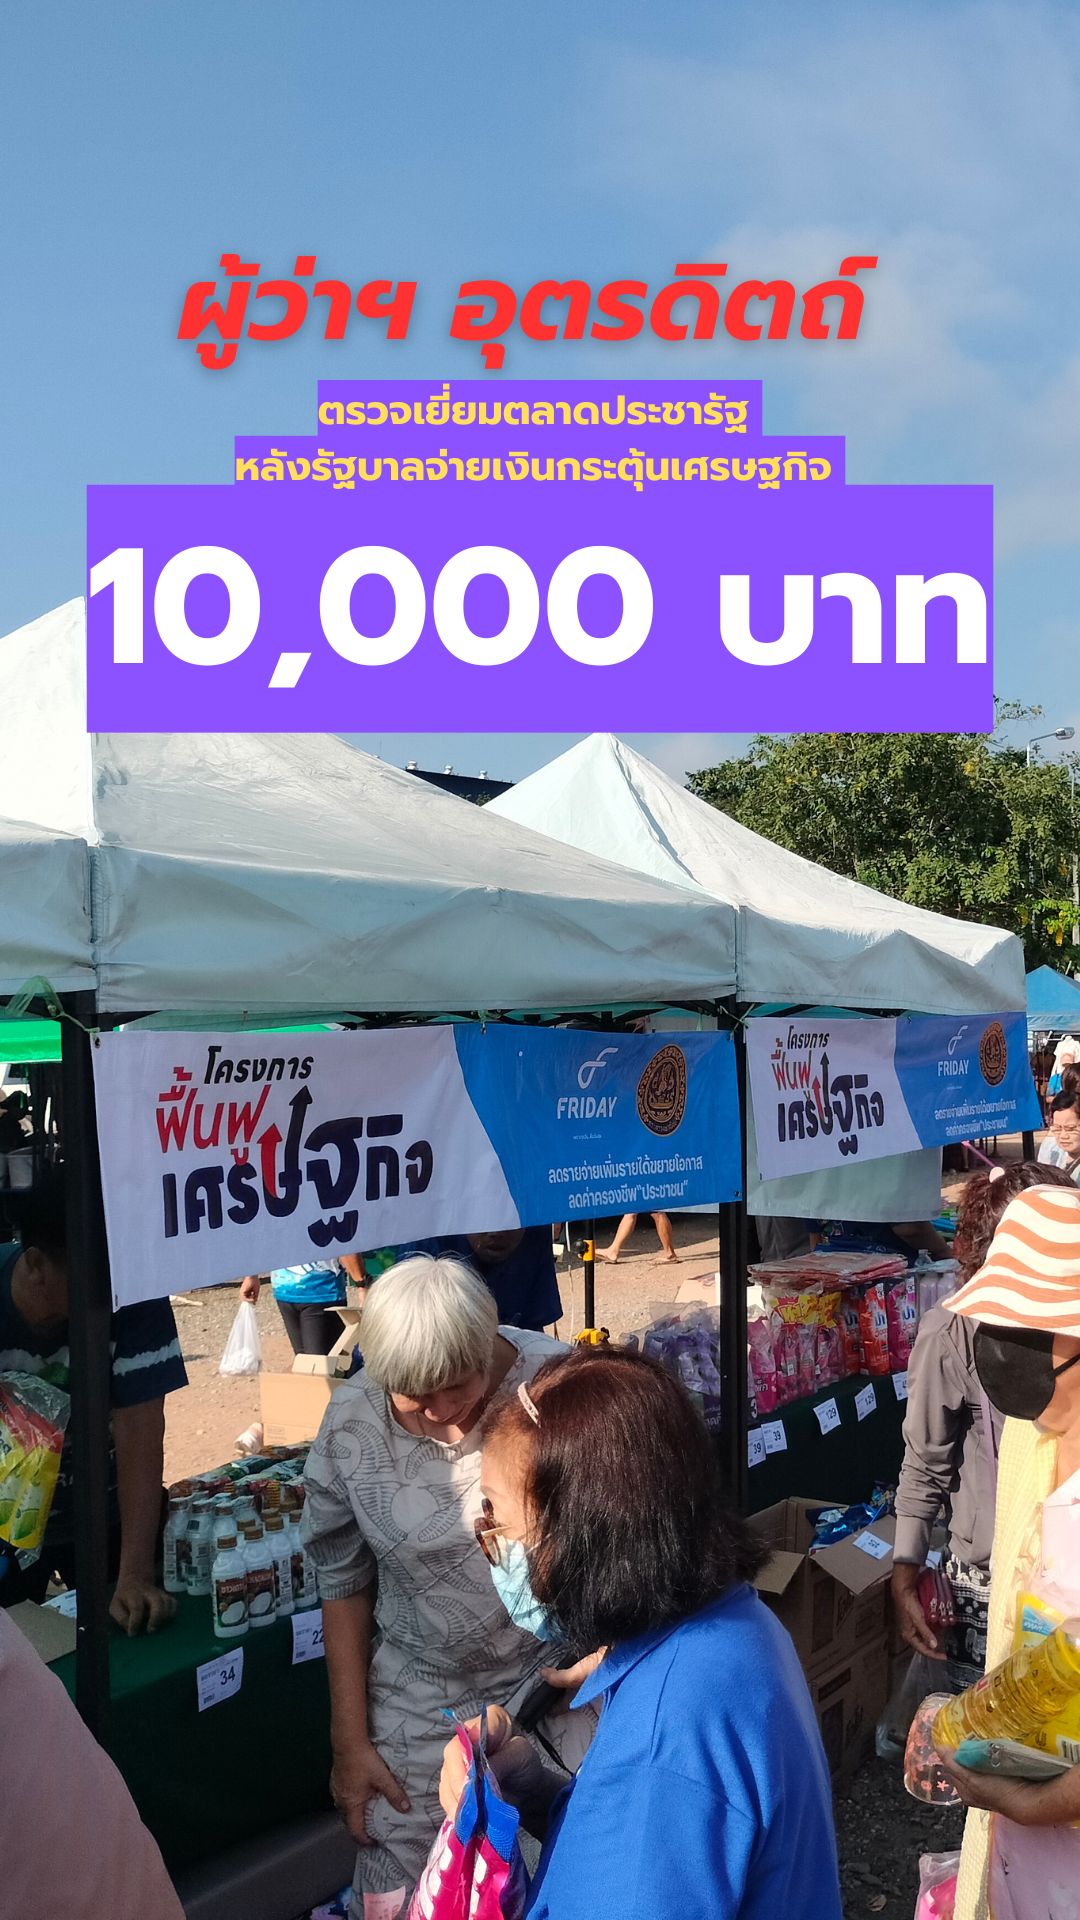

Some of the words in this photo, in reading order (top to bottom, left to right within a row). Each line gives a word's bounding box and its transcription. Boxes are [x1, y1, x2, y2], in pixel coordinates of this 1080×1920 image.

[787, 1025, 830, 1050] โครงการ
[204, 1045, 314, 1085] โครงการ
[938, 1060, 969, 1077] FRIDAY
[156, 1066, 272, 1166] ฟื้นฟู
[556, 1096, 618, 1120] FRIDAY
[162, 1085, 434, 1248] เศรษฐกิจ
[548, 1153, 703, 1184] ลดรายจ่ายเพิ่มรายได้ขยายโอกาส
[825, 1407, 838, 1421] 129
[772, 1430, 782, 1442] 39
[752, 1443, 762, 1455] 39
[220, 1665, 236, 1686] 34
